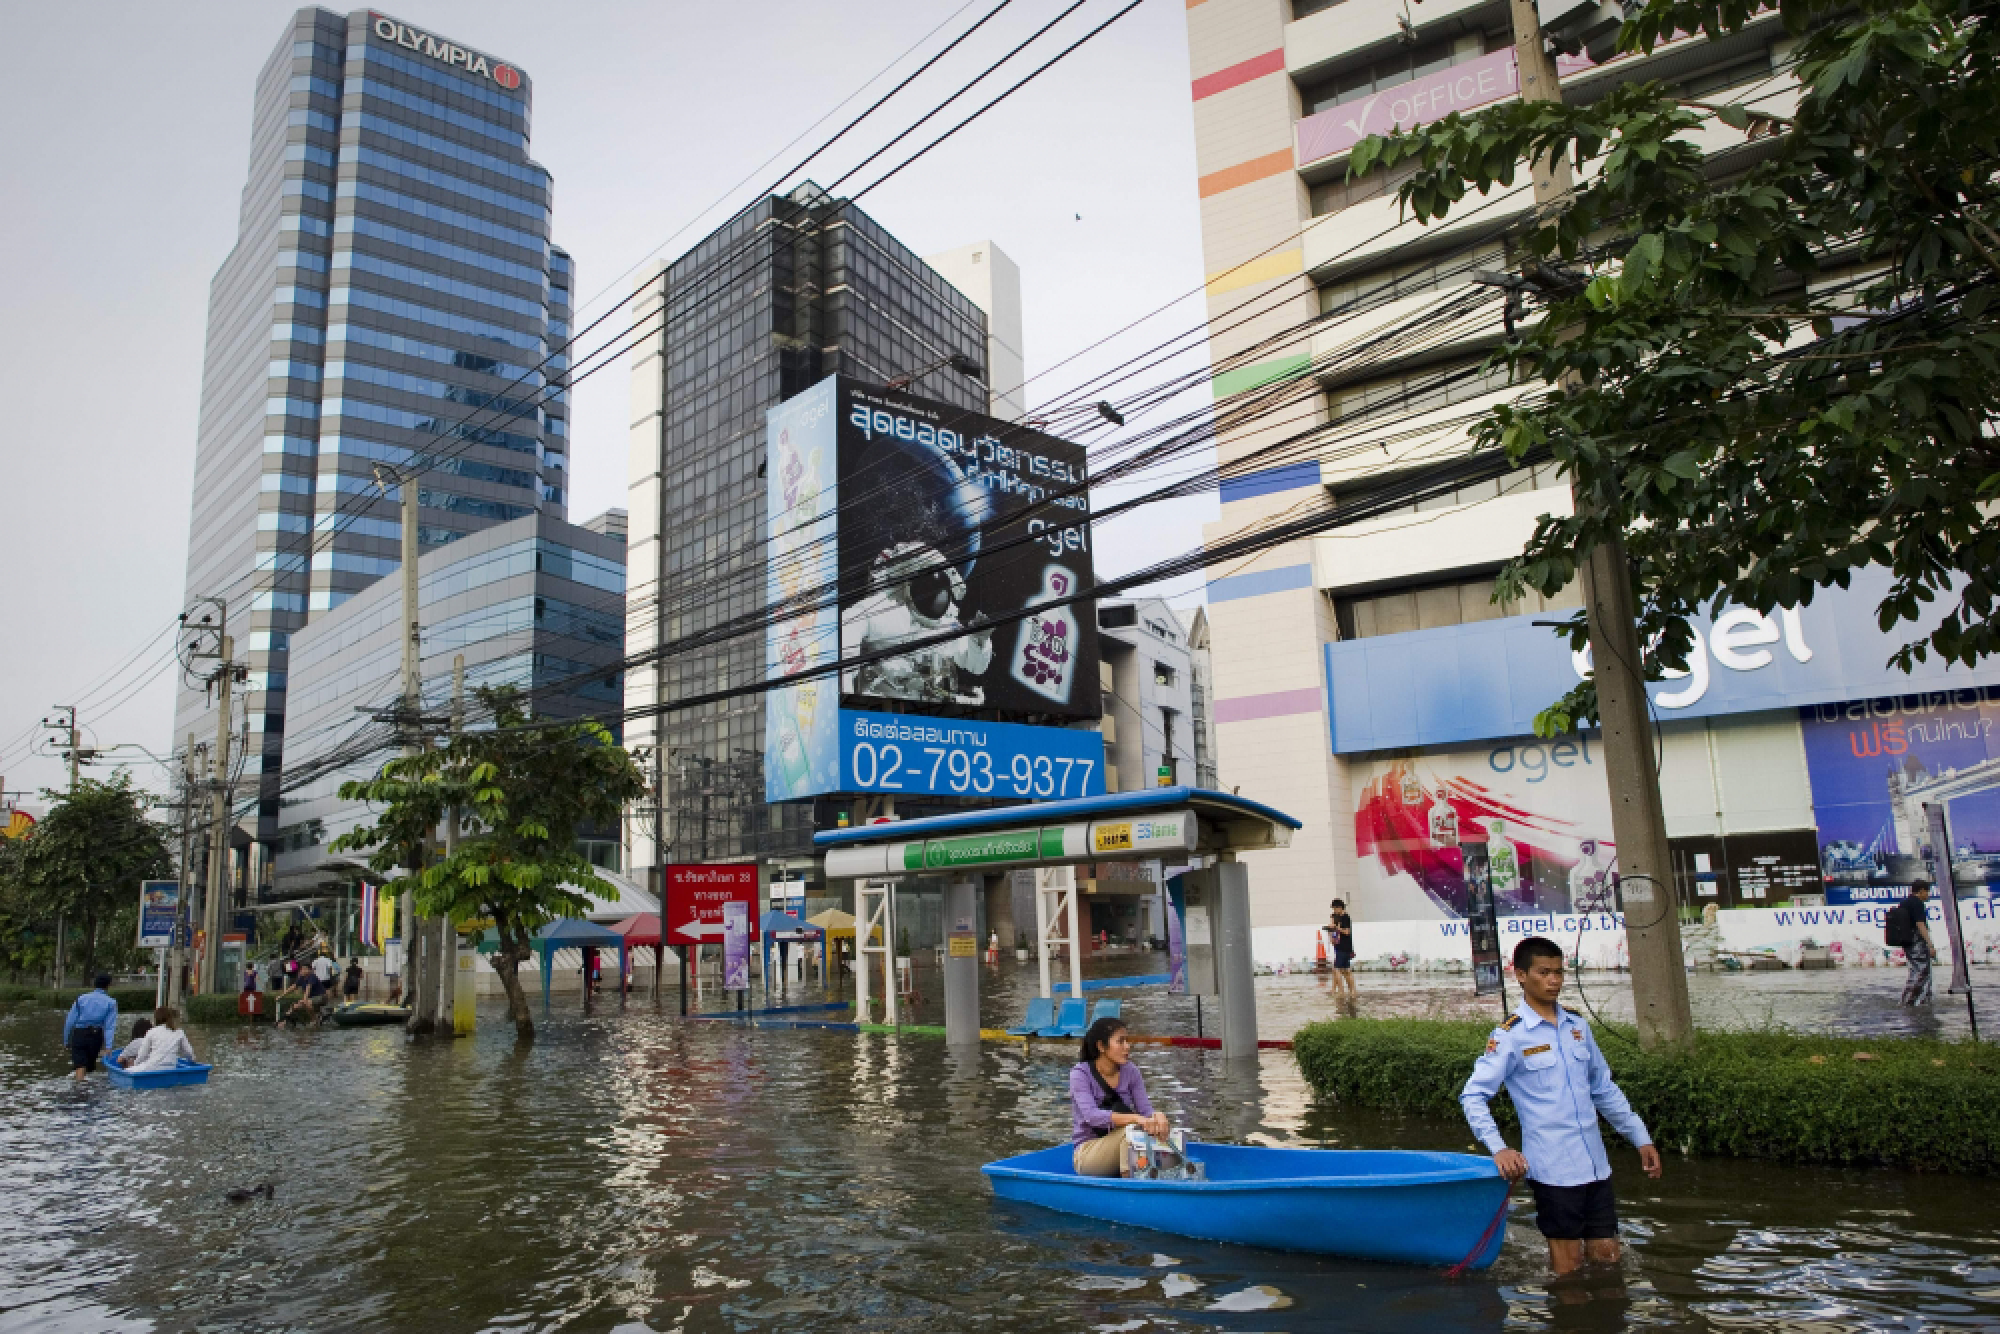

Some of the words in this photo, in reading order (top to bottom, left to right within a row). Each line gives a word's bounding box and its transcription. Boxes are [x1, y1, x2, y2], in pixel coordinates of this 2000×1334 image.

[375, 18, 491, 79] OLYMPIA
[1388, 67, 1496, 125] OFFICE
[854, 717, 987, 747] ติดต่อสอบถาม
[1488, 732, 1592, 783] agel
[852, 742, 1095, 797] 02-793-9377
